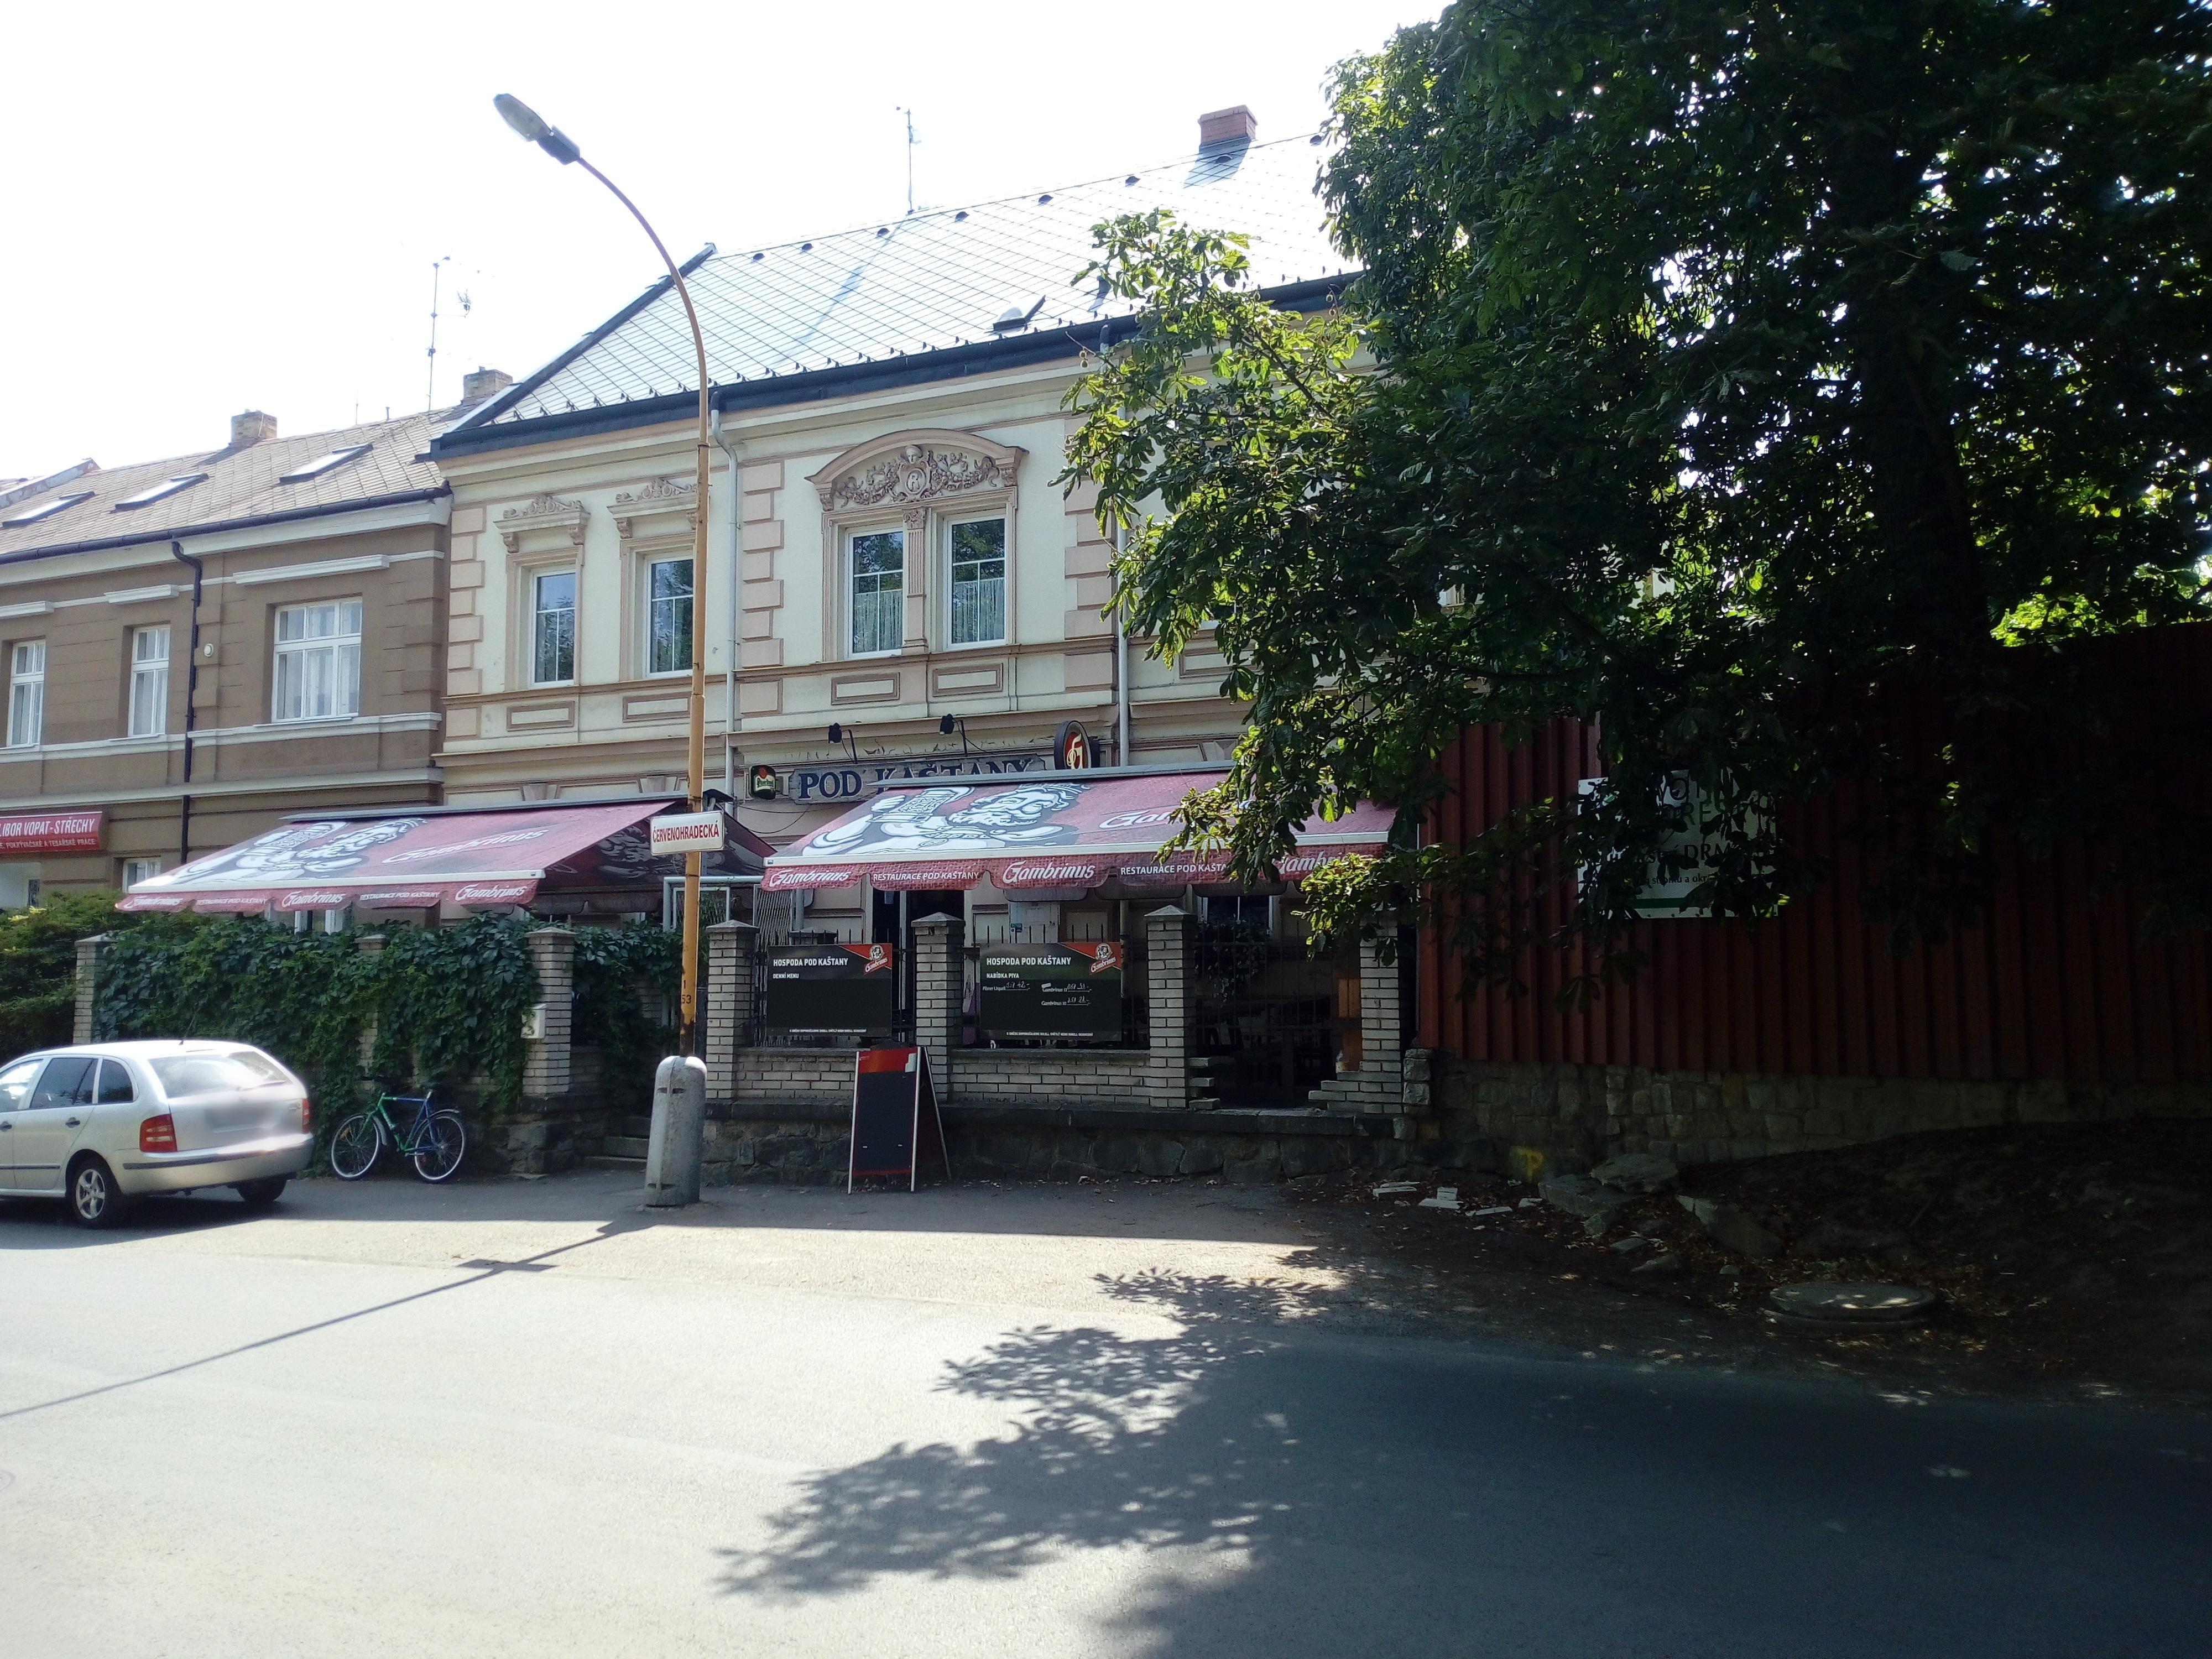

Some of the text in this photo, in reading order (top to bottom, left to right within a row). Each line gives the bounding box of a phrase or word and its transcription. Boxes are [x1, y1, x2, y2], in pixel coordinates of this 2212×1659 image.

[798, 770, 864, 800] POD
[54, 817, 95, 834] STŘECHY
[653, 820, 719, 842] ČERVENOHRADECKÁ
[941, 870, 978, 880] KAŠTANY
[1002, 860, 1096, 884] Gambrinus
[1120, 862, 1227, 875] RESTAURACE POD KAŠTA
[769, 870, 852, 887] Gambrinus
[281, 885, 347, 907] Gambrinus
[455, 884, 528, 901] Gambrinus
[804, 958, 817, 966] POD
[818, 956, 848, 966] KAŠTANY
[987, 957, 1020, 966] HOSPODA
[1037, 954, 1071, 965] KAŠTANY
